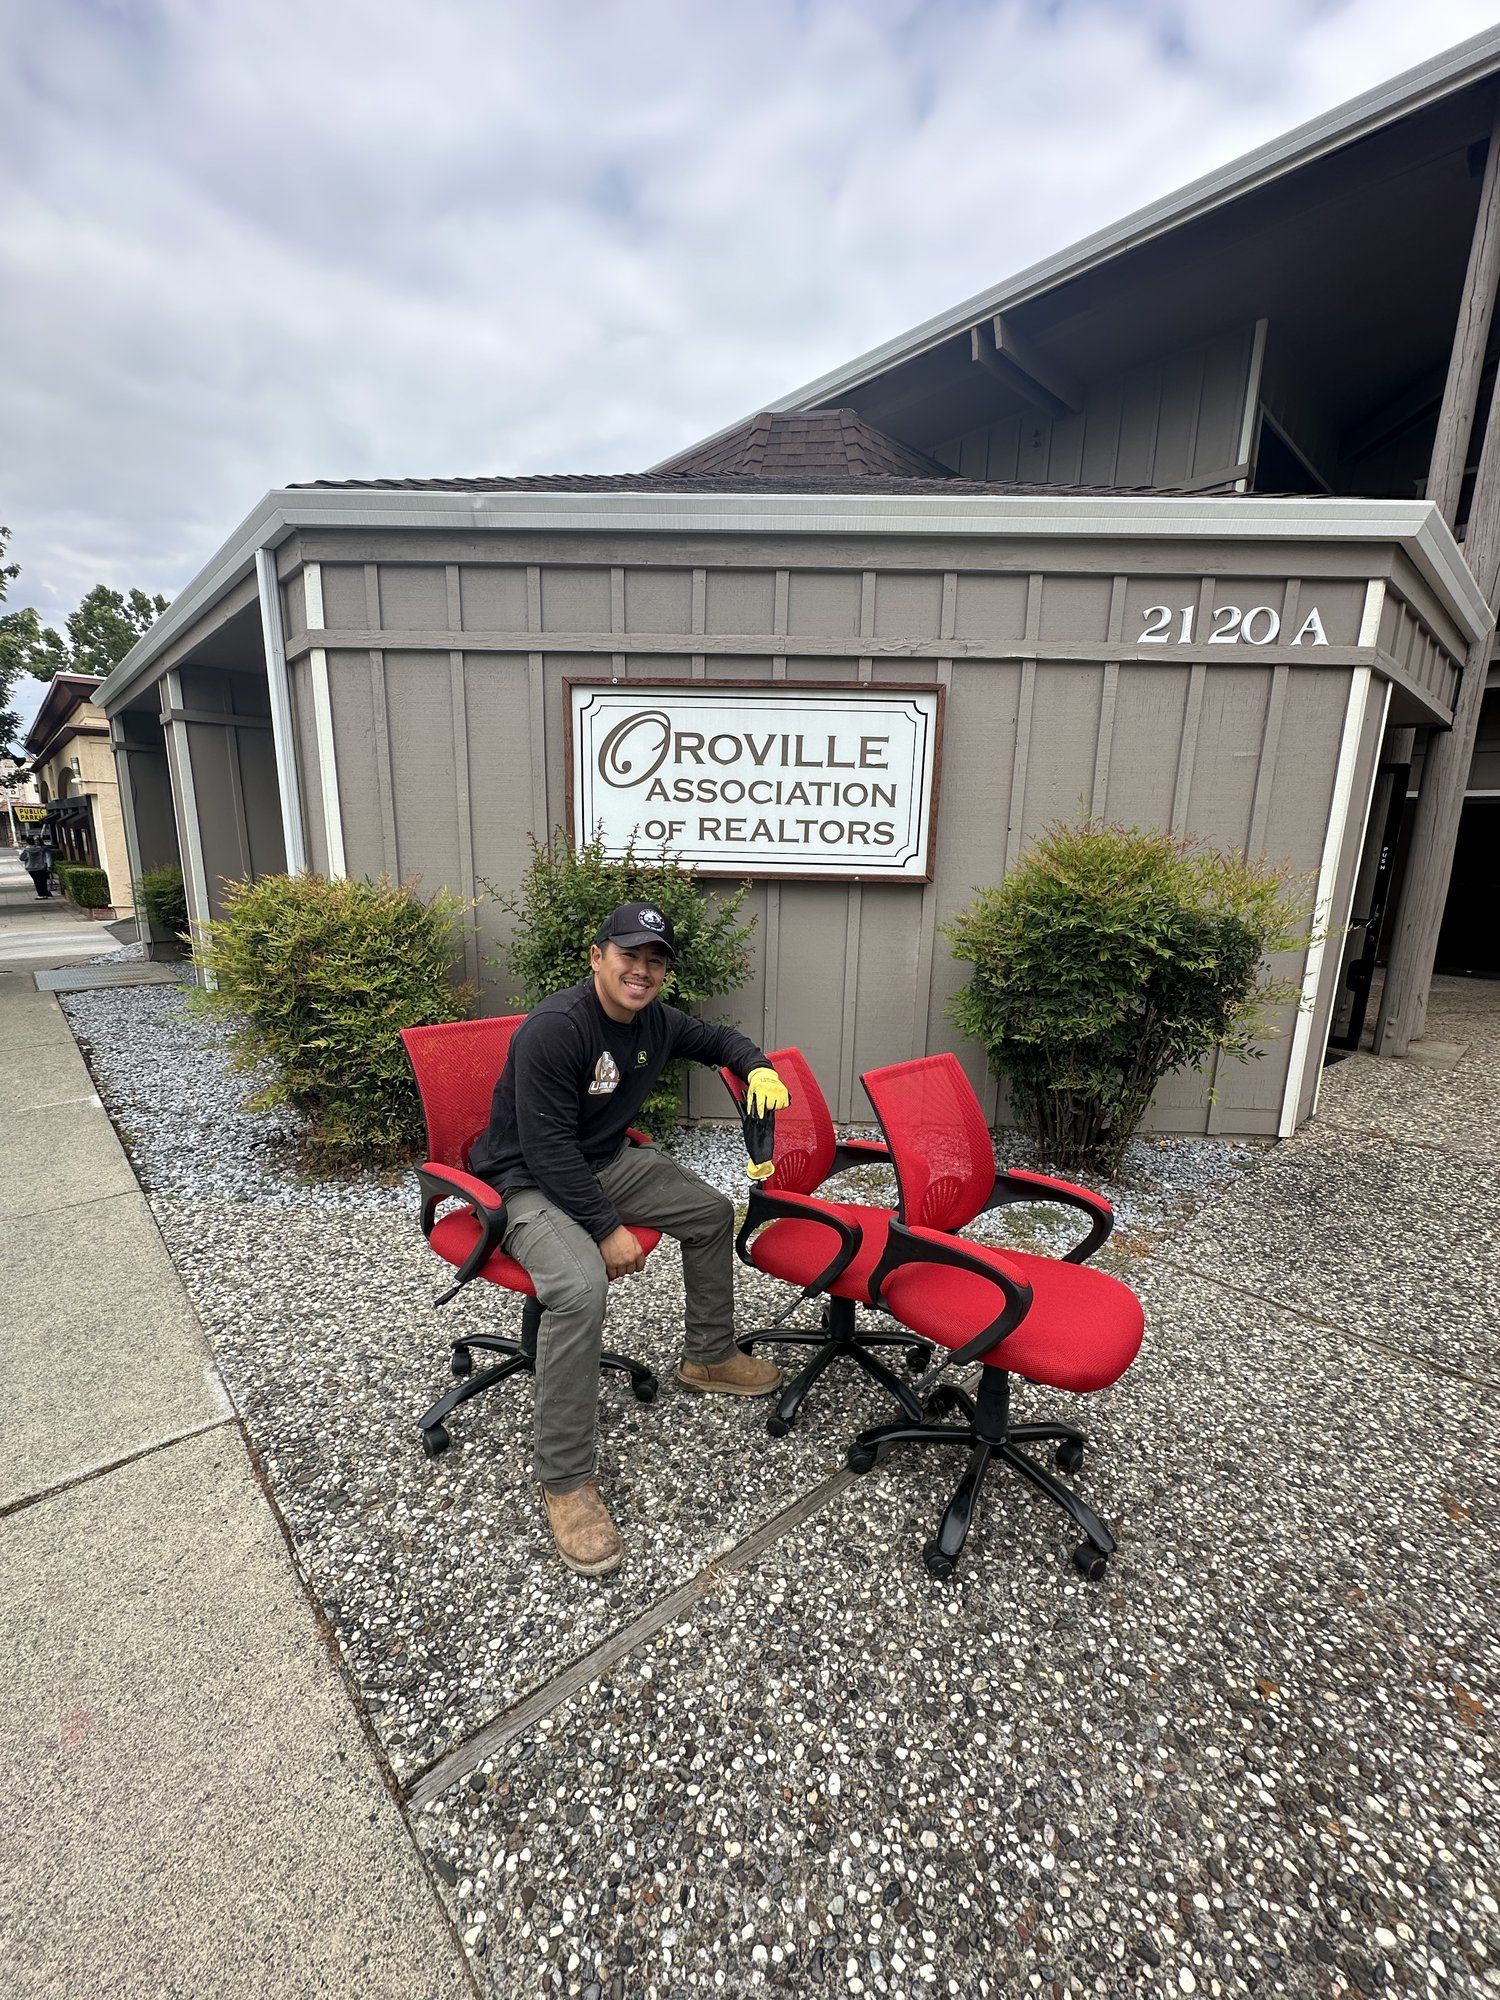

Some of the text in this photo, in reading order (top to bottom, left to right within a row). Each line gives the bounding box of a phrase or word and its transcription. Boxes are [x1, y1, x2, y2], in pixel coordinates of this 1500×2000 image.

[1137, 605, 1330, 646] 2120 A
[598, 710, 890, 788] OROVILLE
[645, 777, 897, 808] ASSOCIATION
[644, 816, 895, 846] OF REALTORS
[1380, 846, 1389, 870] PUSH
